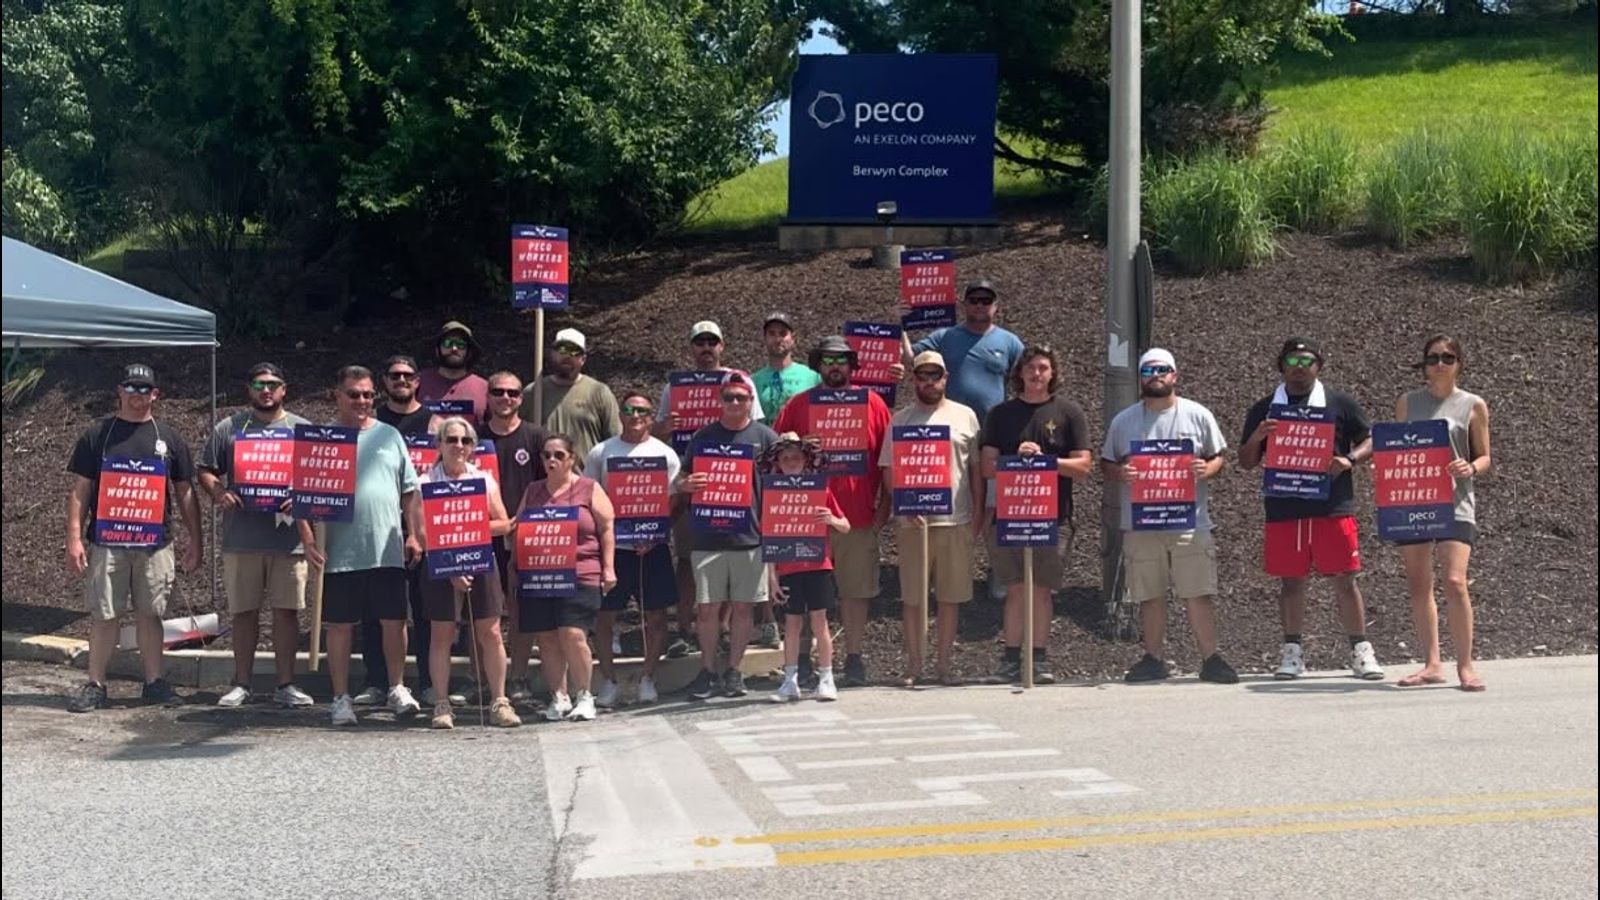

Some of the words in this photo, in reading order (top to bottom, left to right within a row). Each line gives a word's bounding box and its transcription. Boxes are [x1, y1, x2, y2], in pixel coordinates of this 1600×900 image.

[855, 102, 924, 128] peco
[854, 135, 870, 144] AN
[874, 135, 917, 145] EXELON
[920, 135, 977, 145] COMPANY
[853, 165, 896, 178] Berwyn
[899, 165, 949, 178] Complex
[858, 351, 894, 362] ORKERS
[827, 408, 852, 418] PECO
[816, 419, 862, 429] WORKERS
[1288, 424, 1316, 435] PECO
[826, 438, 859, 446] TRIKE!
[1275, 436, 1328, 448] WORKERS
[312, 446, 338, 456] PECO
[912, 444, 936, 453] PECO
[300, 457, 350, 470] WORKERS
[901, 455, 946, 465] WORKERS
[1150, 458, 1176, 468] PECO
[1277, 455, 1321, 468] STRIKE!
[1396, 453, 1426, 465] PECO
[711, 461, 736, 471] PECO
[1139, 470, 1188, 480] WORKERS
[1384, 466, 1441, 480] WORKERS
[119, 477, 147, 487] PECO
[304, 477, 345, 489] STRIKE!
[626, 475, 652, 484] PECO
[705, 473, 746, 484] ORKERS
[905, 474, 944, 484] STRIKE!
[1015, 474, 1040, 484] PECO
[107, 488, 159, 500] WORKERS
[616, 485, 663, 495] WORKERS
[1004, 486, 1051, 496] WORKERS
[1143, 489, 1185, 499] STRIKE!
[1390, 488, 1438, 502] STRIKE!
[702, 491, 742, 502] STRIKE!
[782, 494, 808, 503] PECO
[919, 494, 941, 502] peco
[444, 500, 470, 512] PECO
[620, 504, 661, 514] STRIKE!
[770, 505, 815, 514] WORKER
[1008, 506, 1048, 515] STRIKE!
[110, 507, 152, 519] STRIKE!
[433, 511, 483, 525] WORKERS
[1409, 511, 1435, 522] peco
[535, 524, 560, 534] PECO
[635, 523, 658, 532] peco
[774, 524, 816, 533] STRIKE!
[440, 531, 481, 545] STRIKE!
[524, 536, 571, 546] WORKERS
[456, 552, 481, 564] peco
[528, 555, 567, 566] STRIKE!
